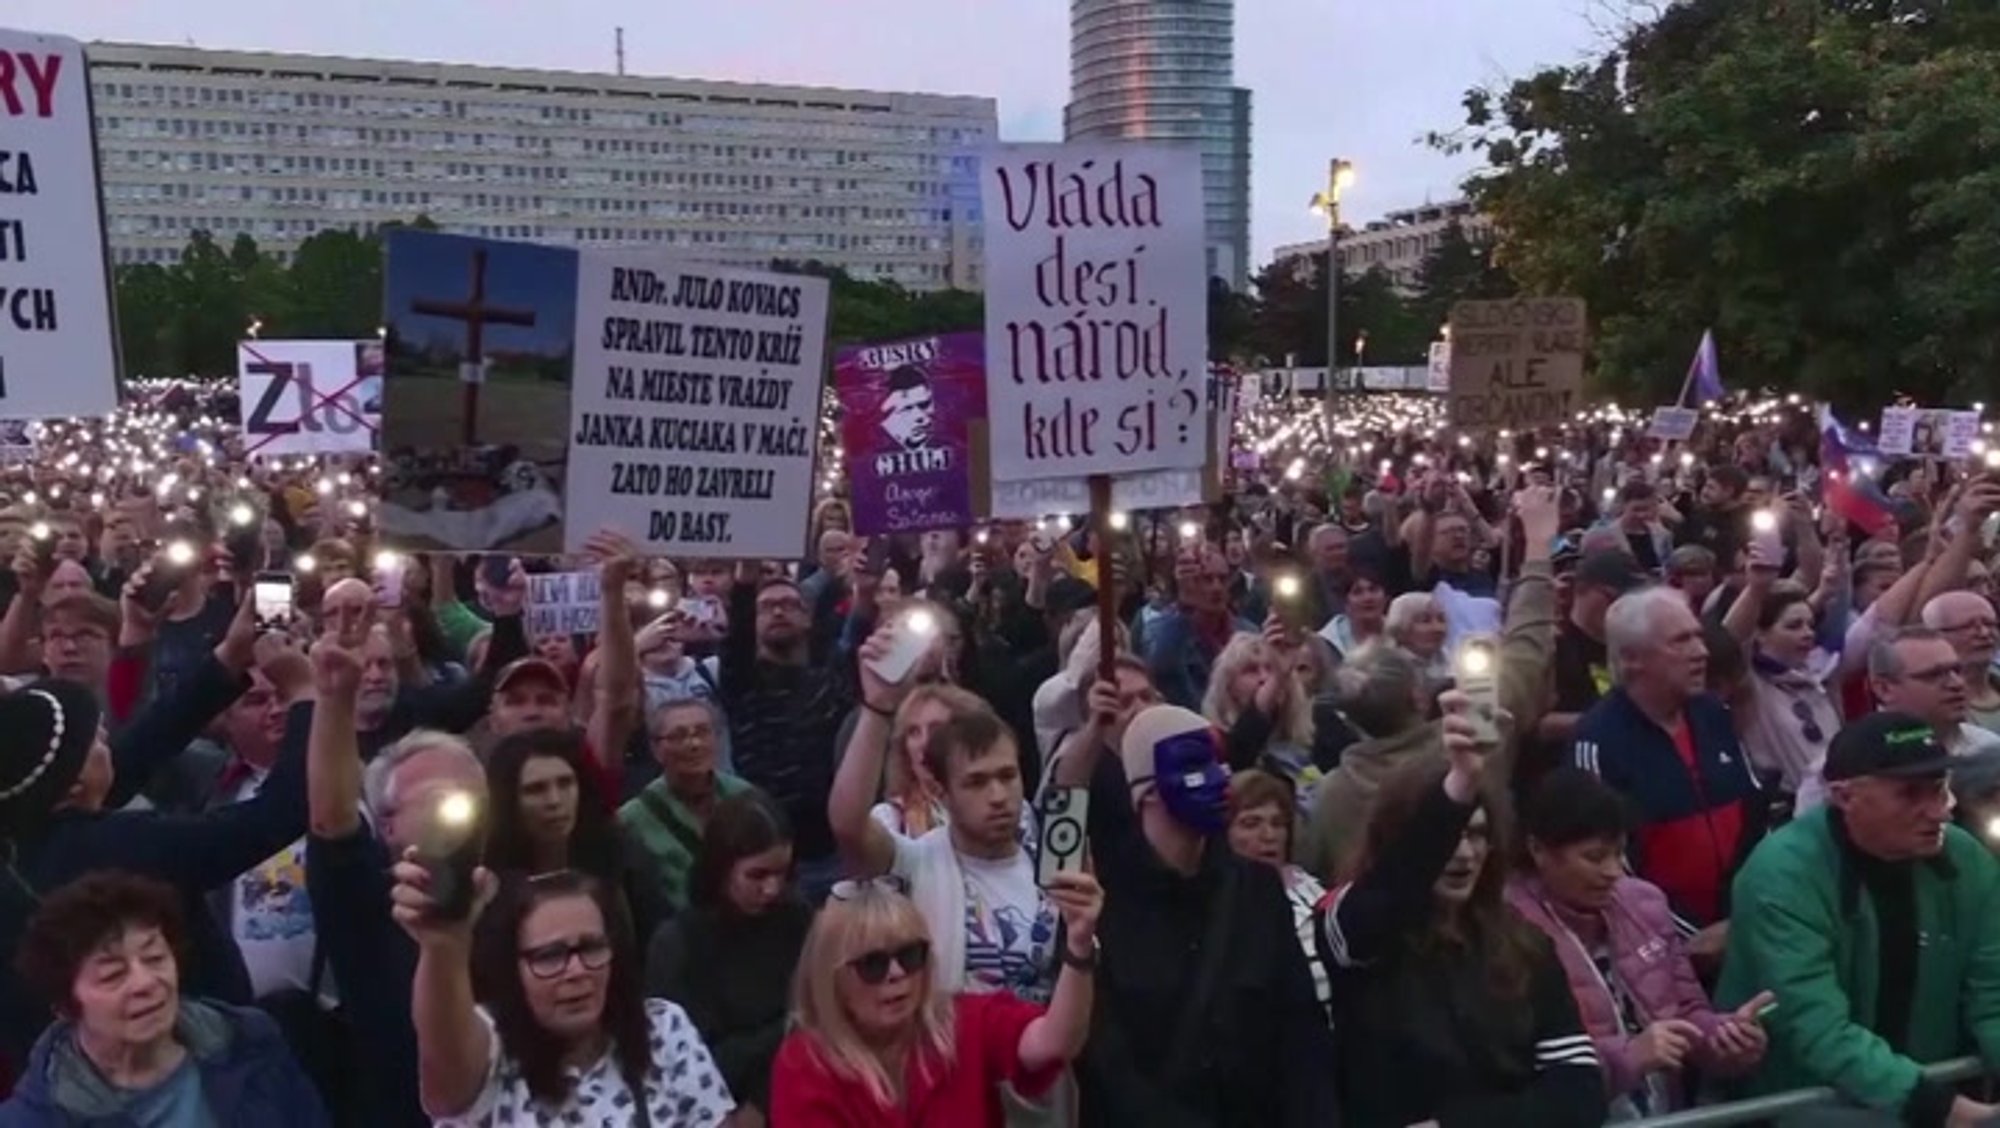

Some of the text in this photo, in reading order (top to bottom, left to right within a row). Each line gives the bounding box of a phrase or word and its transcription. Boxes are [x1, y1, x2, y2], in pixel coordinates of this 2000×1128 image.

[996, 159, 1162, 232] Vláda
[610, 266, 802, 319] RNDr. JULO KOVACS
[601, 316, 803, 366] SPRAVIL TENTO KRÍŽ
[1006, 306, 1189, 385] národ,
[606, 366, 793, 411] NA MIESTE VRAŽDY
[1488, 357, 1549, 390] ALE
[576, 412, 644, 449] JANKA
[649, 416, 736, 453] KUCIAKA
[741, 421, 757, 453] V
[1023, 397, 1100, 460] kde
[611, 462, 775, 501] ZATO HO ZAVRELI
[648, 510, 733, 544] DO BASY.
